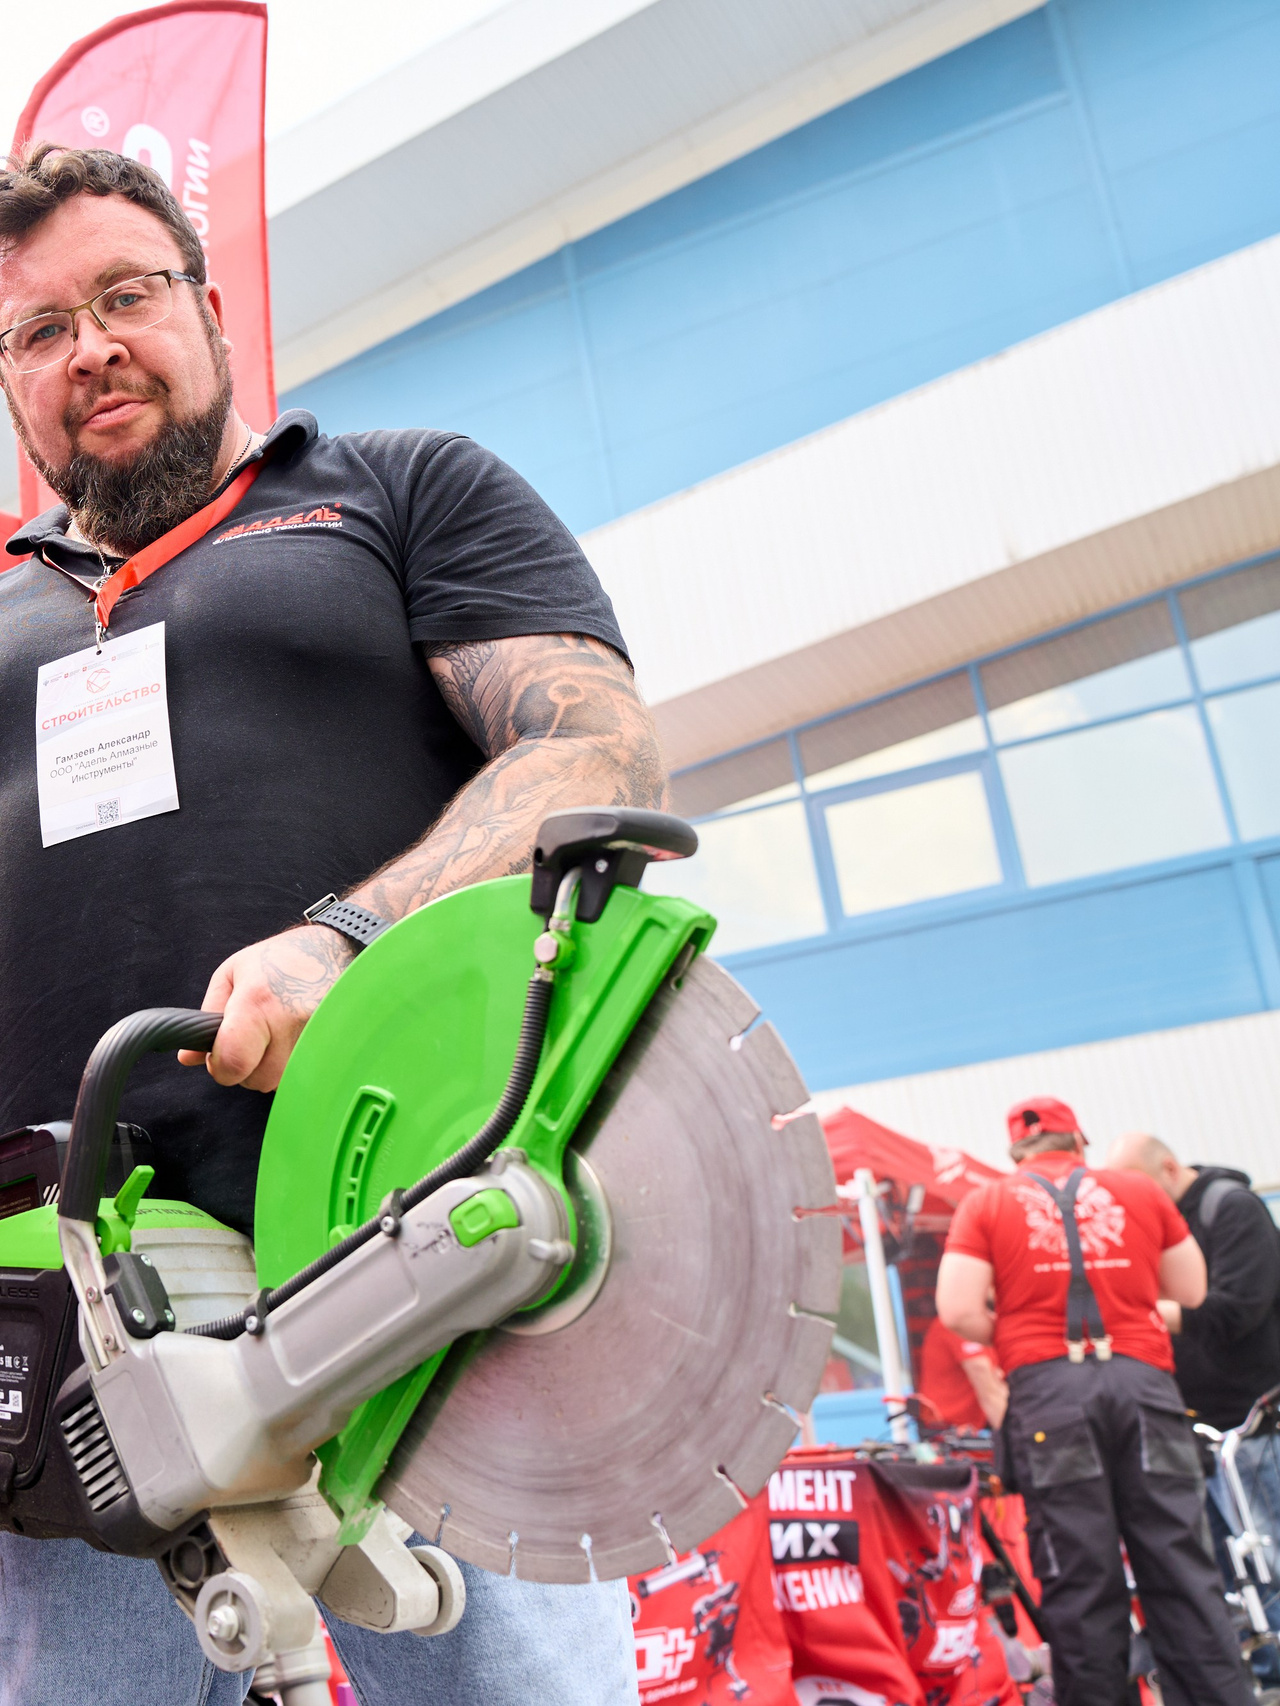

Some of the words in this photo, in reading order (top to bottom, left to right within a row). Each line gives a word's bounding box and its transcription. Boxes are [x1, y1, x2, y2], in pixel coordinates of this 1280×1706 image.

[41, 683, 161, 731] СТРОИТЕЛЬСТВО
[50, 765, 73, 779] ООО
[110, 740, 158, 760] Алмазные
[55, 747, 95, 765] Гамзеев
[97, 729, 151, 752] Александр
[71, 756, 138, 784] Инструменты"
